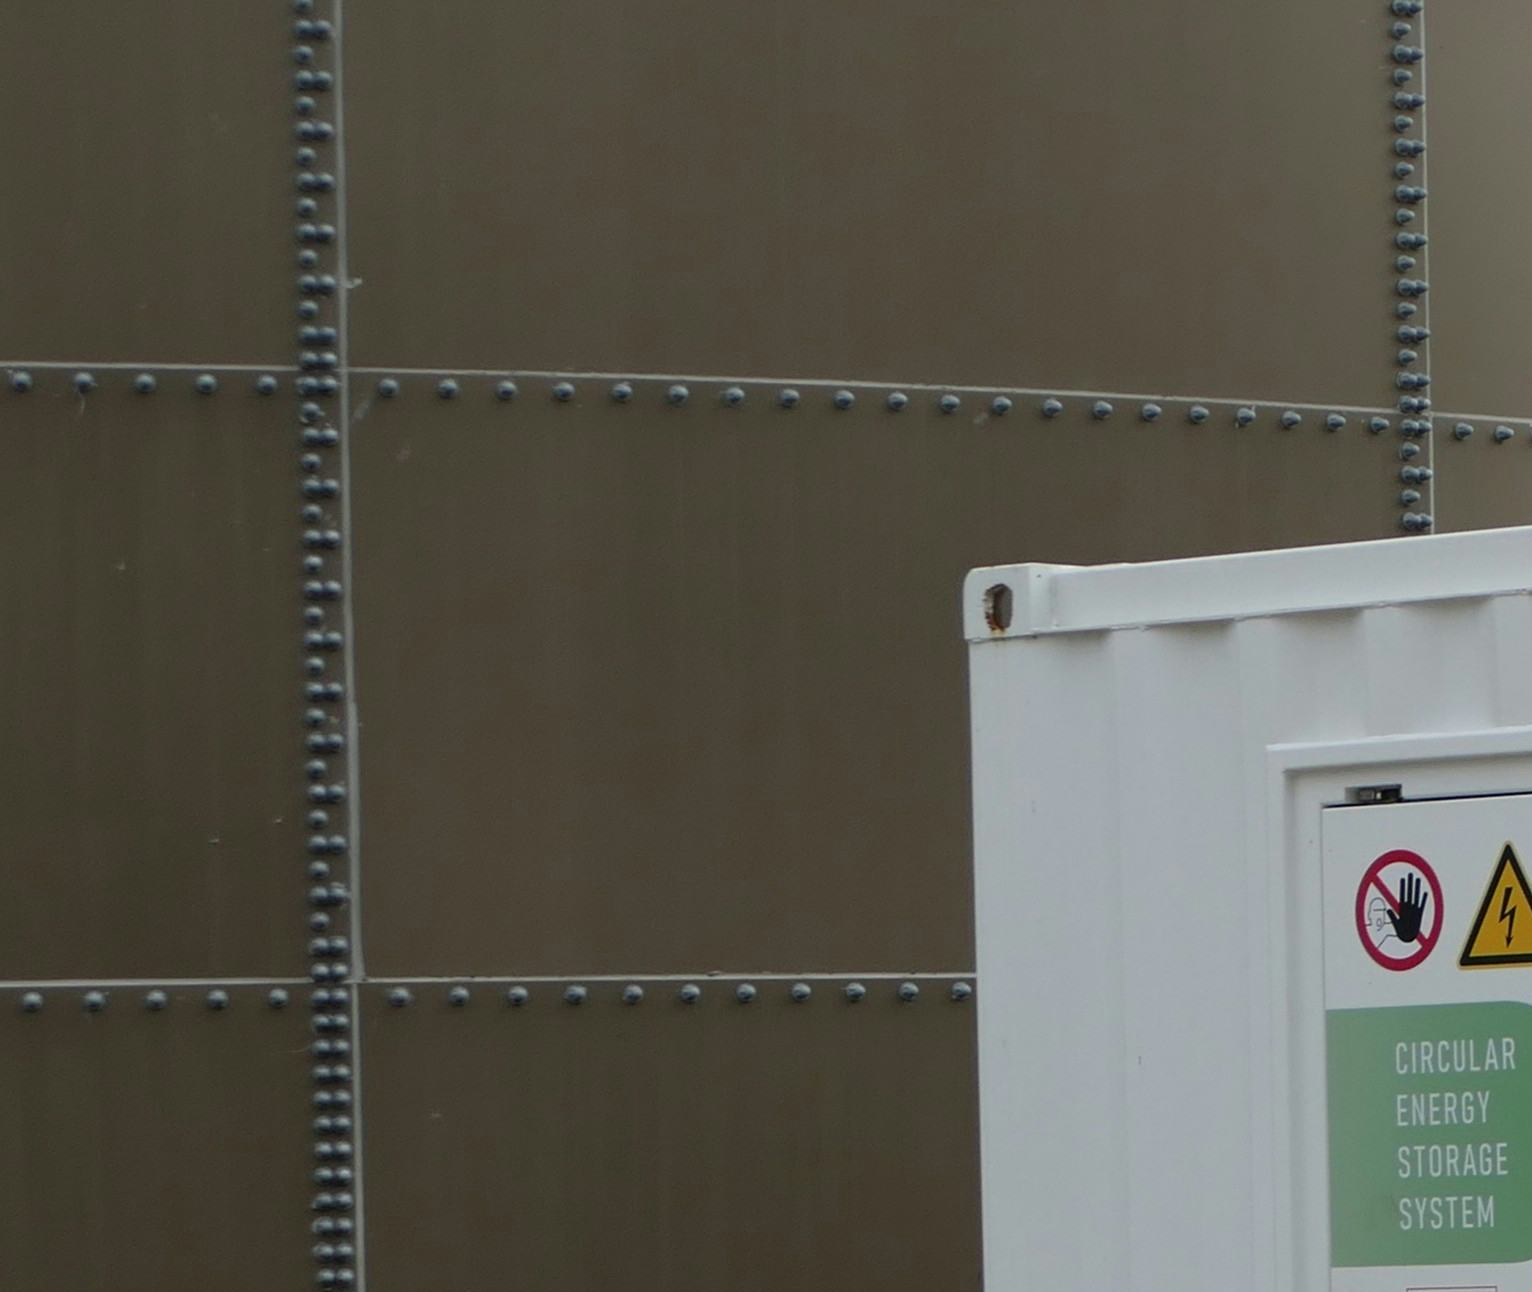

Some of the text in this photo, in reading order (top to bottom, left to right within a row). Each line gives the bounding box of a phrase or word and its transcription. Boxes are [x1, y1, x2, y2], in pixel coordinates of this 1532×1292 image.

[1395, 1037, 1517, 1075] CIRCULAR
[1396, 1091, 1491, 1127] ENERGY
[1398, 1143, 1508, 1178] STORAGE
[1400, 1196, 1495, 1231] SYSTEM
